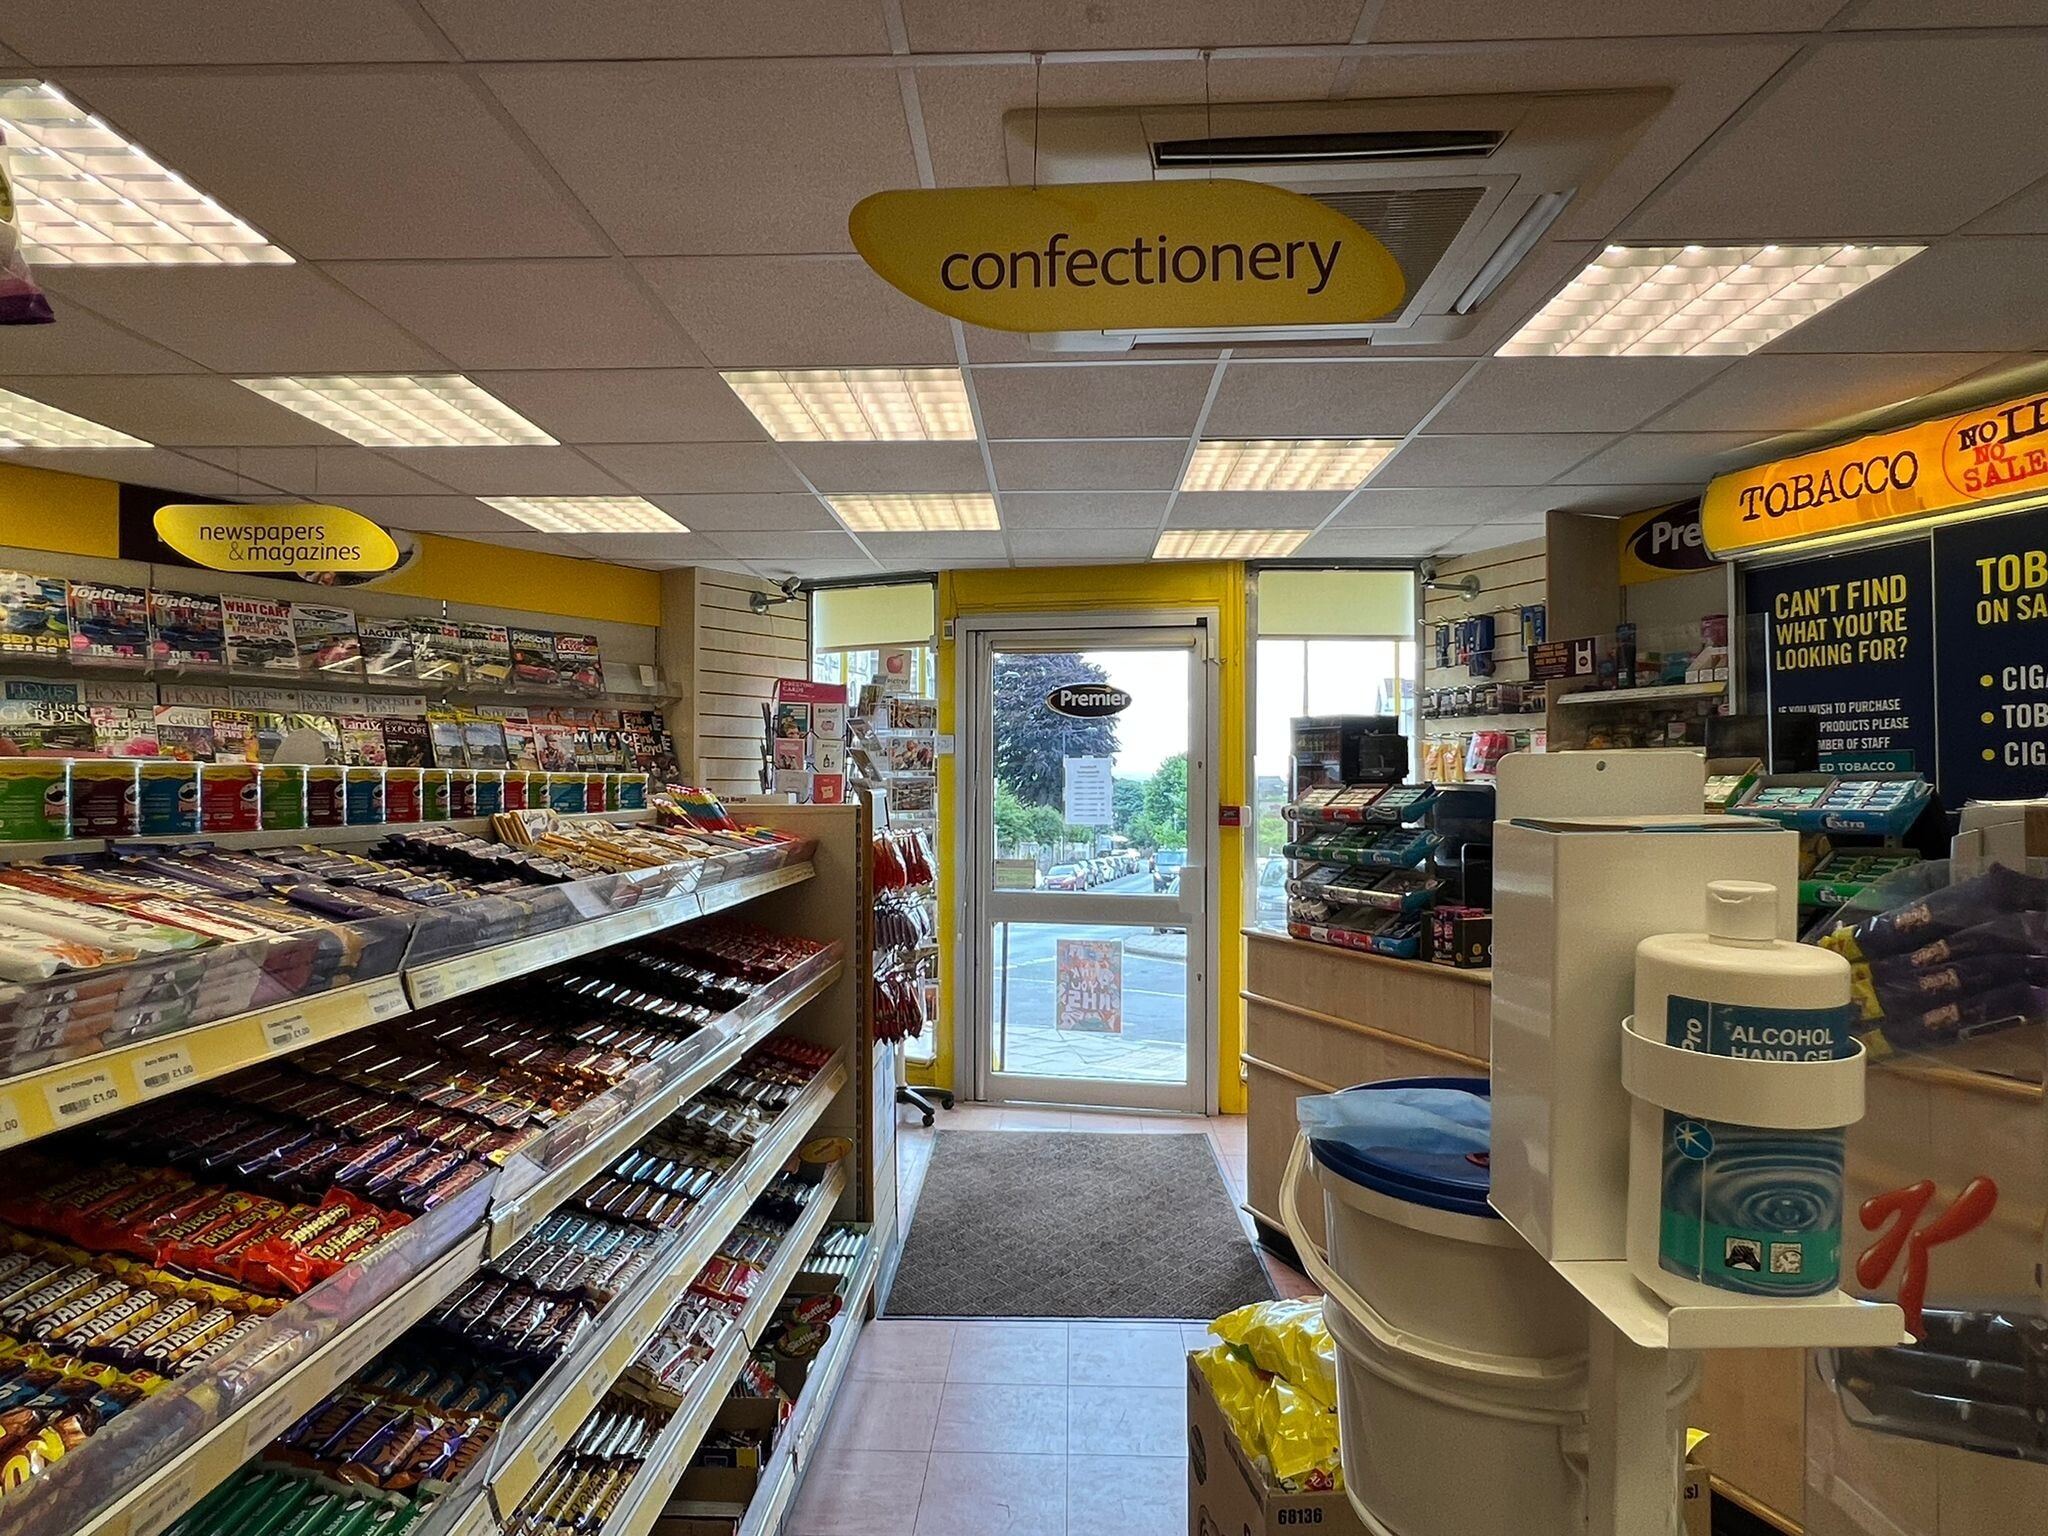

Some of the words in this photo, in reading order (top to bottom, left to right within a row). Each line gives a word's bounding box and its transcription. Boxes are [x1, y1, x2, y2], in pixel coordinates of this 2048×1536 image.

[940, 233, 1342, 296] confectionery
[1957, 421, 1998, 451] NO
[1973, 443, 2006, 466] NO
[1739, 450, 1919, 522] TOBACCO
[1963, 448, 2048, 493] SALE
[200, 525, 325, 545] newspapers
[1775, 584, 1840, 620] CAN'T
[1847, 574, 1907, 610] FIND
[223, 600, 258, 614] WHAT
[259, 604, 290, 618] CAR?
[1976, 598, 2009, 625] ON
[1775, 618, 1827, 646] WHAT
[1833, 607, 1908, 638] YOU'RE
[1775, 642, 1852, 671] LOOKING
[1858, 636, 1908, 663] FOR?
[1060, 689, 1129, 707] Premier
[1807, 702, 1833, 715] WISH
[1835, 702, 1847, 714] TO
[1848, 698, 1901, 713] PURCHASE
[211, 710, 238, 721] FREE
[1819, 719, 1870, 733] PRODUCTS
[1872, 716, 1909, 731] PLEASE
[95, 727, 142, 738] World
[385, 725, 427, 736] EXPLORE
[635, 743, 663, 756] Floyd
[1846, 738, 1860, 749] OF
[1861, 736, 1891, 749] STAFF
[1837, 761, 1896, 772] TOBACCO
[1730, 1027, 1834, 1046] ALCOHOL
[172, 1064, 194, 1078] £1.00
[93, 1088, 118, 1104] £1.00
[2, 1267, 98, 1324] STARBAR
[33, 1280, 129, 1338] STARBAR
[64, 1289, 158, 1348] STARBAR
[110, 1297, 197, 1358] STARBAR
[1277, 1507, 1323, 1525] 68136
